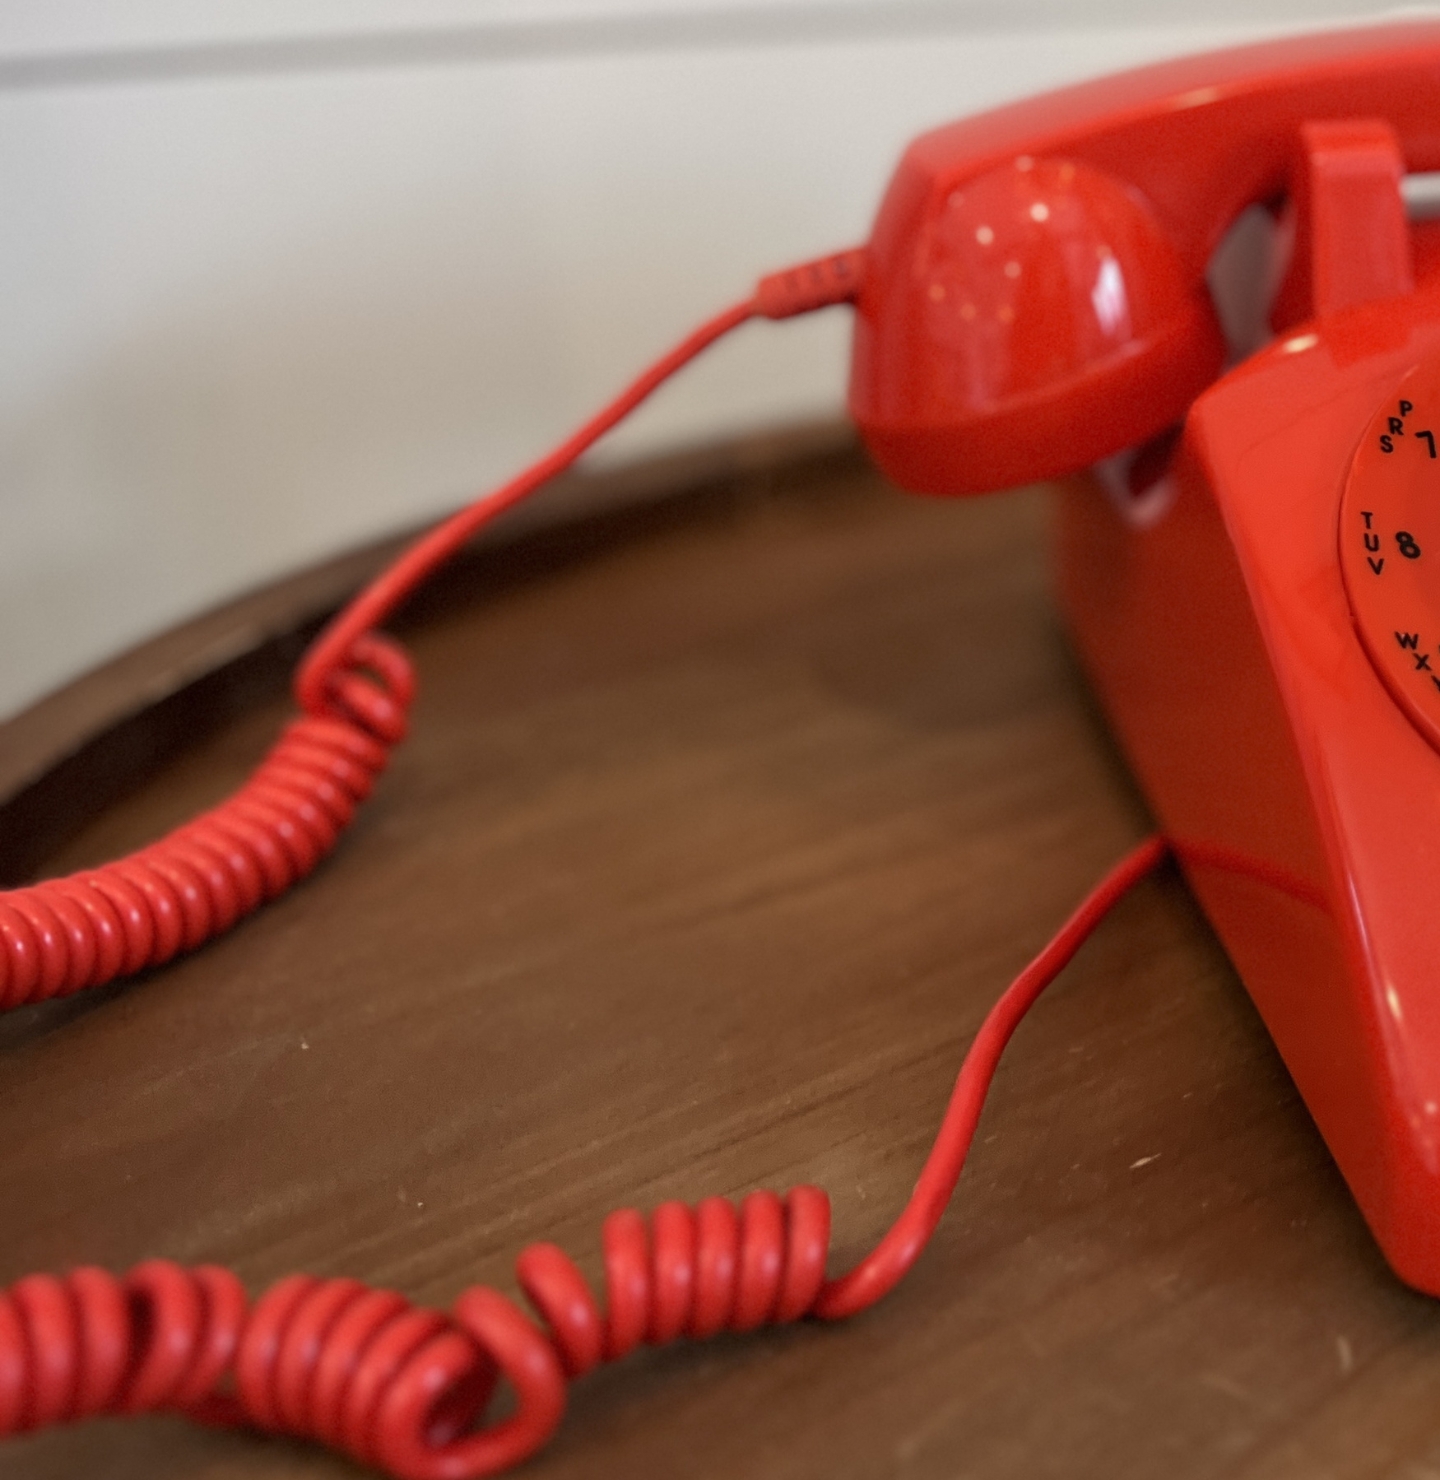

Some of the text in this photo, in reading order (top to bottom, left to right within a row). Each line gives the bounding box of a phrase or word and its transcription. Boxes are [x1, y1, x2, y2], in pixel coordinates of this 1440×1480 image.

[1415, 430, 1437, 458] 7
[1360, 512, 1384, 576] TUV
[1395, 531, 1421, 559] 8
